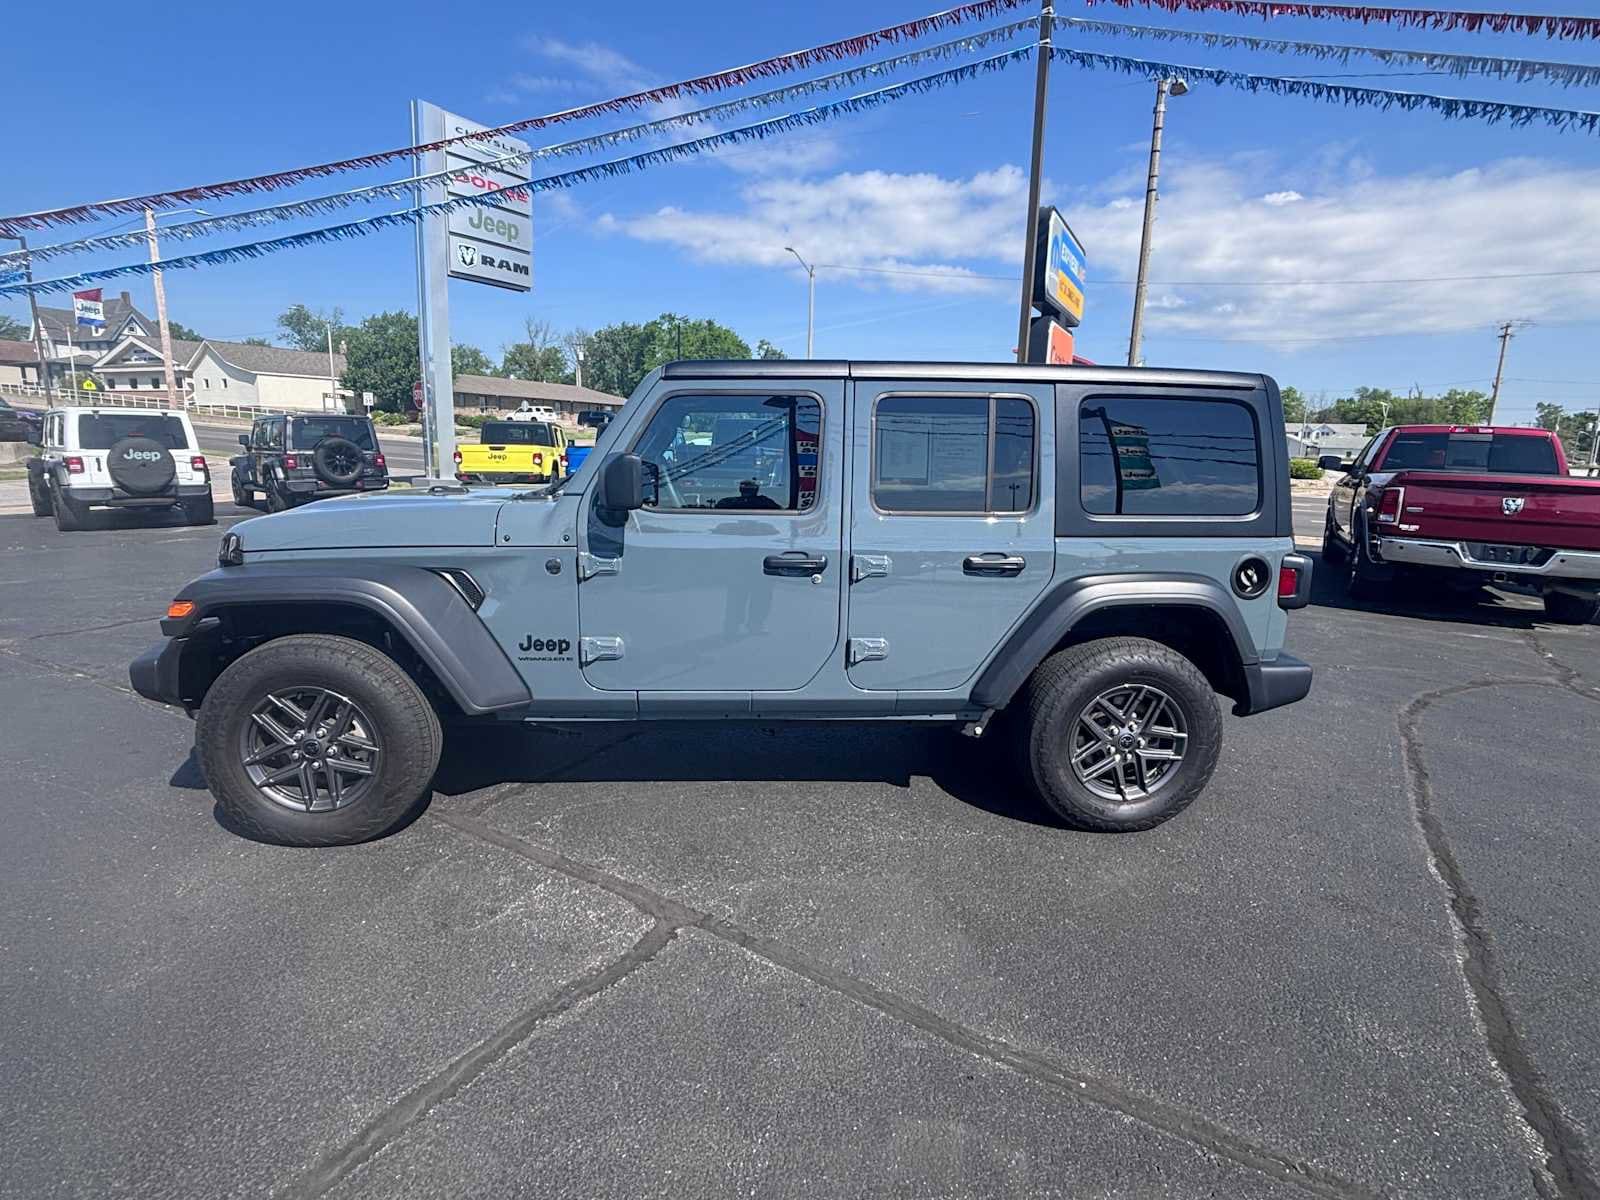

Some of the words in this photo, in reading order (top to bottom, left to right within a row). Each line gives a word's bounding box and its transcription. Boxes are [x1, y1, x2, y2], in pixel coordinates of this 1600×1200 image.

[468, 207, 519, 242] Jeep
[481, 254, 529, 276] RAM
[76, 303, 100, 315] Jeep
[123, 448, 161, 462] Jeep
[487, 452, 508, 461] Jeep
[518, 634, 571, 655] Jeep
